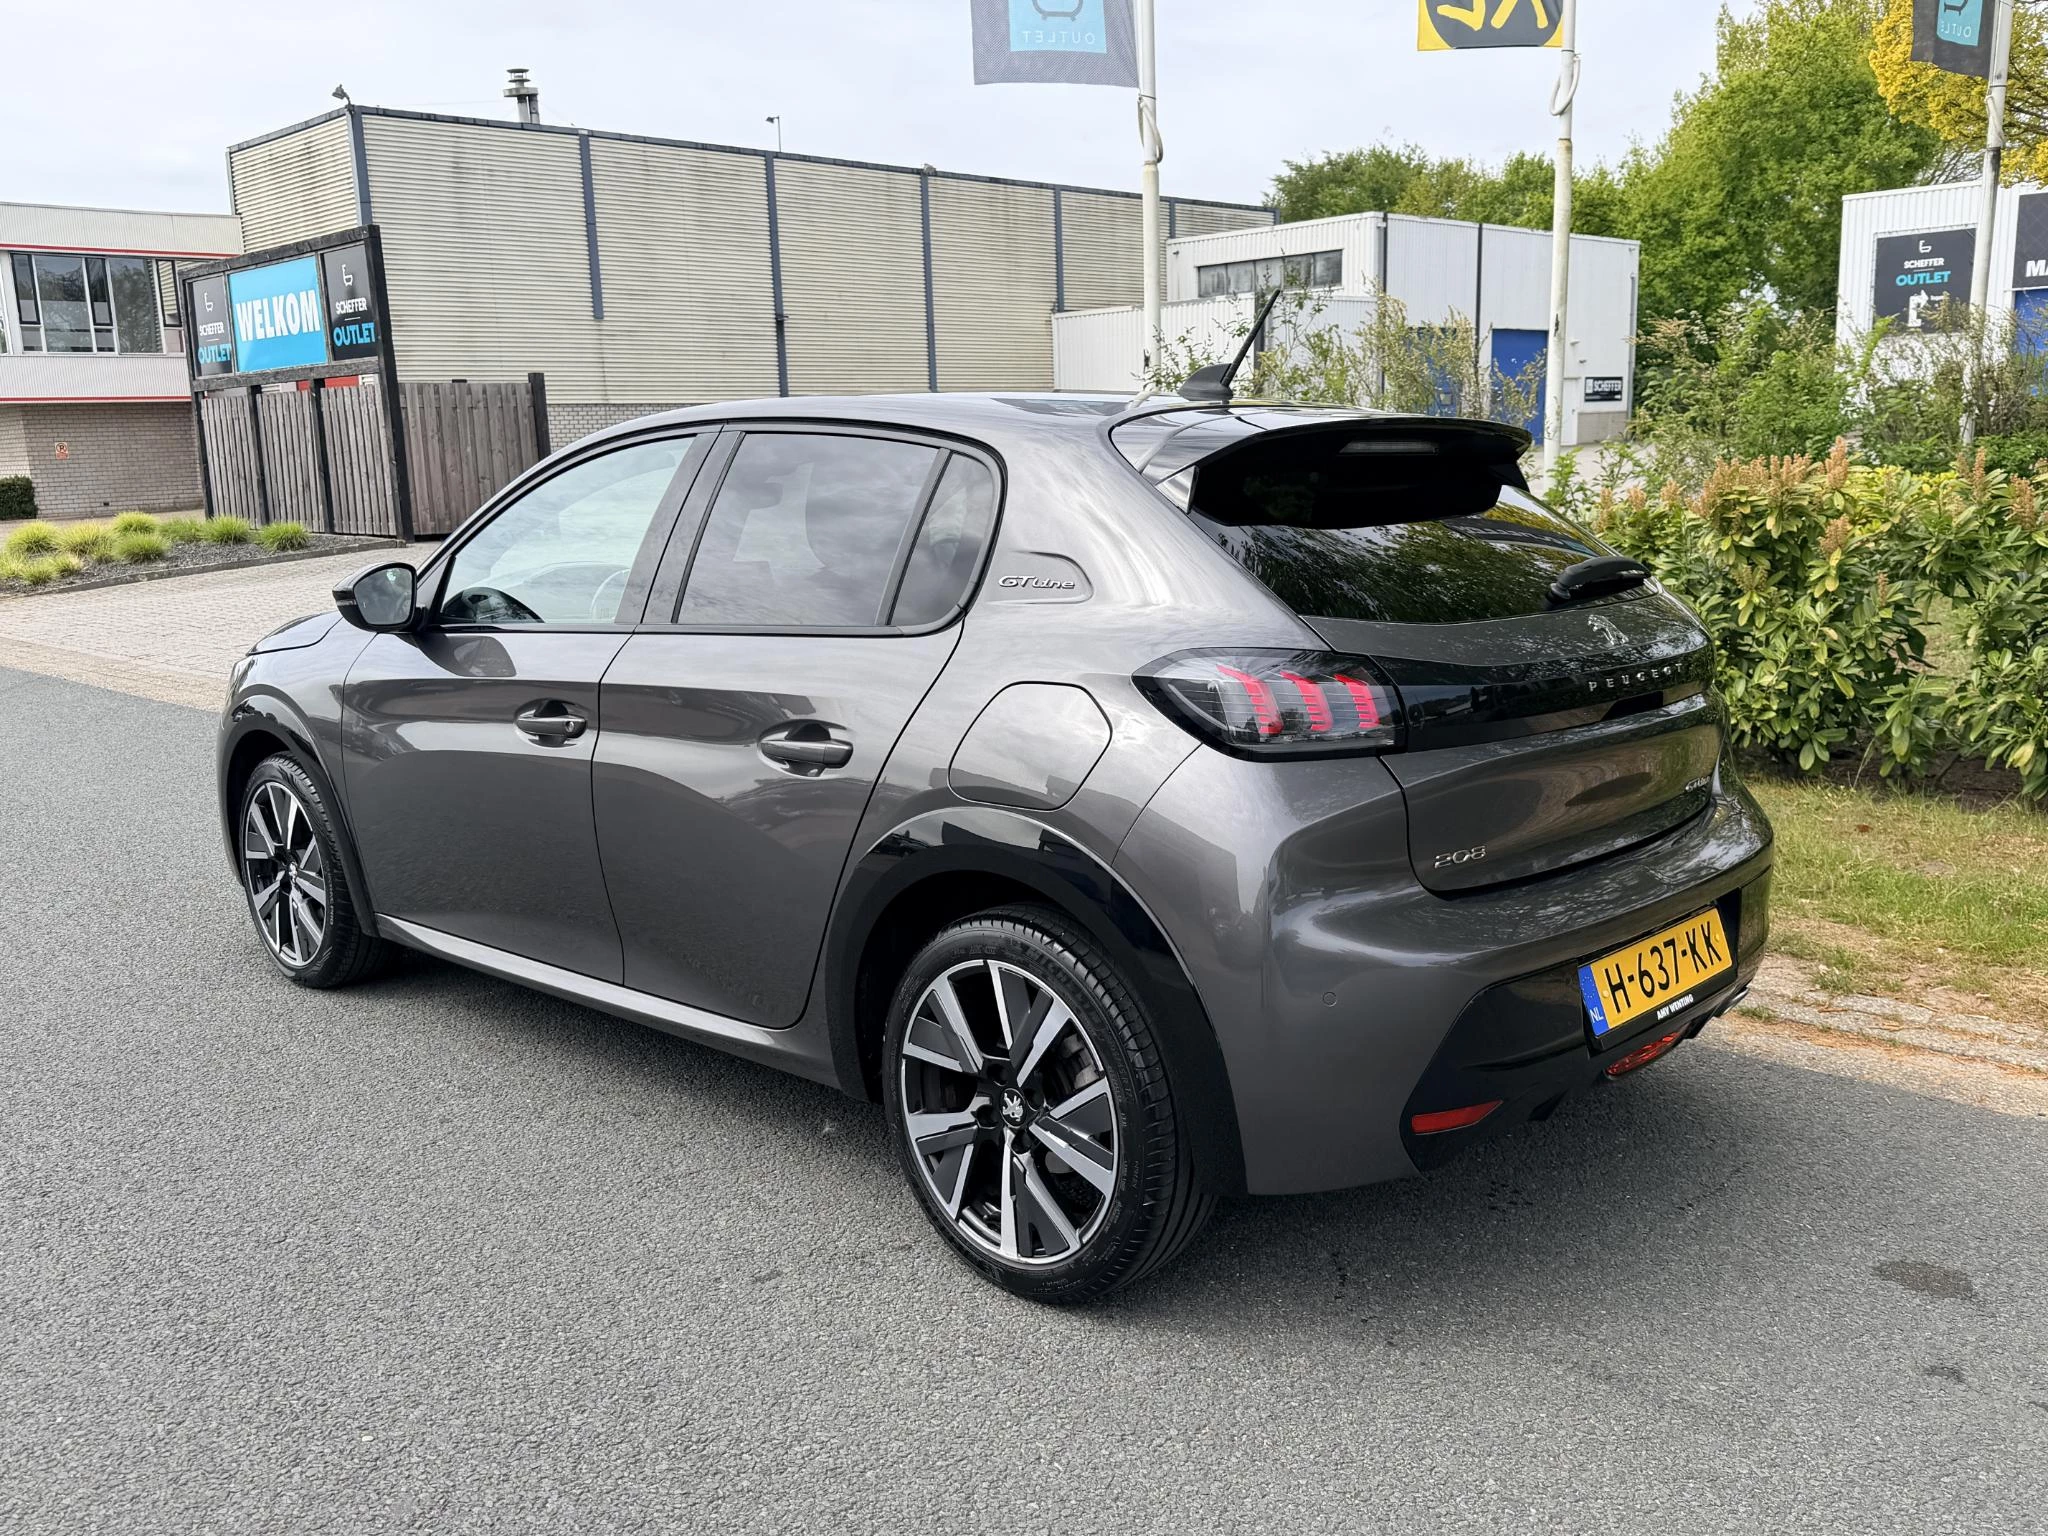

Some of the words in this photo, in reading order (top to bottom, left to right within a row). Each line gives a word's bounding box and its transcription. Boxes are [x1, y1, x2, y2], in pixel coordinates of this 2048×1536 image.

[1904, 257, 1944, 269] SCHEFFER
[1896, 271, 1951, 286] OUTLET
[335, 297, 368, 314] SCHEFFER
[235, 289, 321, 342] WELKOM
[199, 322, 225, 336] SCHEFFER
[333, 322, 376, 347] OUTLET
[198, 343, 231, 364] OUTLET
[1594, 380, 1622, 392] SCHEFFER
[1588, 663, 1683, 692] PEUGEOT
[1434, 845, 1486, 869] 208
[1604, 921, 1722, 1014] H-637-KK
[1589, 1007, 1604, 1024] NL
[1656, 1006, 1670, 1020] AMV
